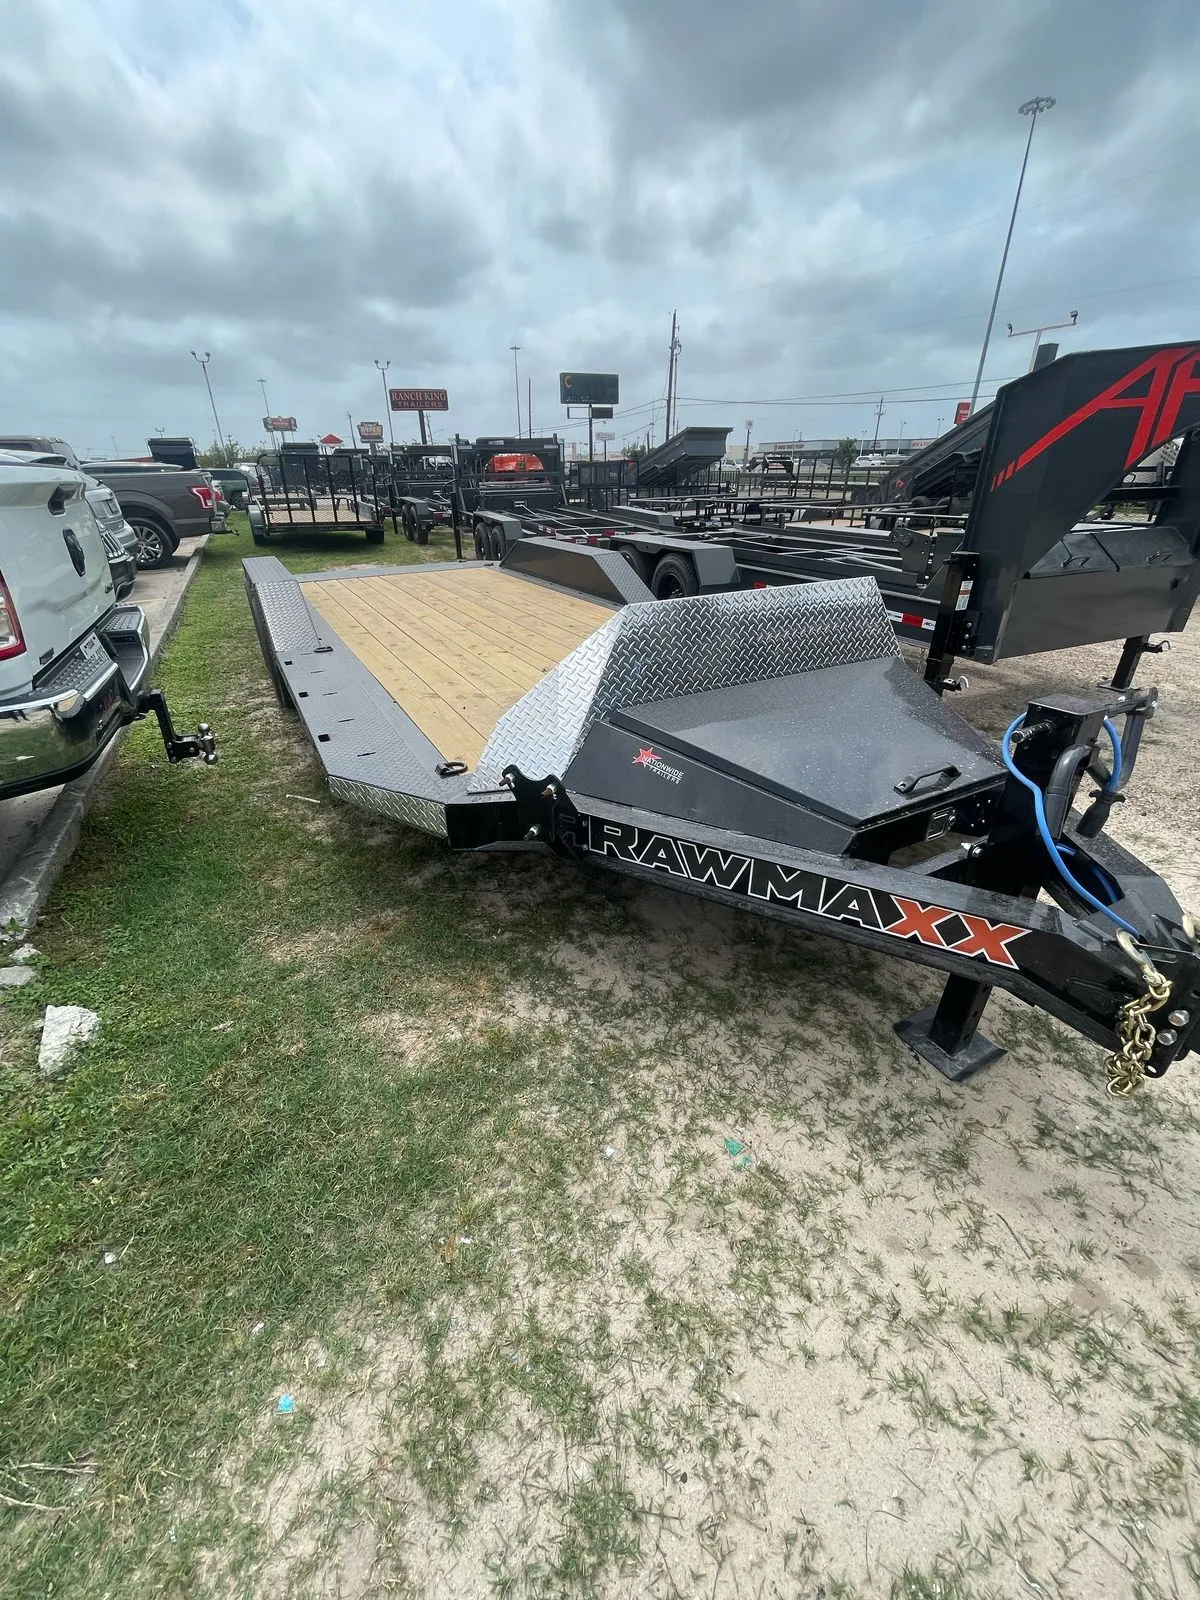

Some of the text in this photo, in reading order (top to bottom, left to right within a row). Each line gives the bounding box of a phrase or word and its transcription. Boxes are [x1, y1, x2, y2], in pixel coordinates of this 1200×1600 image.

[391, 391, 447, 401] RANCH KING
[642, 754, 685, 780] NATIONWIDE
[588, 814, 1032, 971] RAWMAXX
